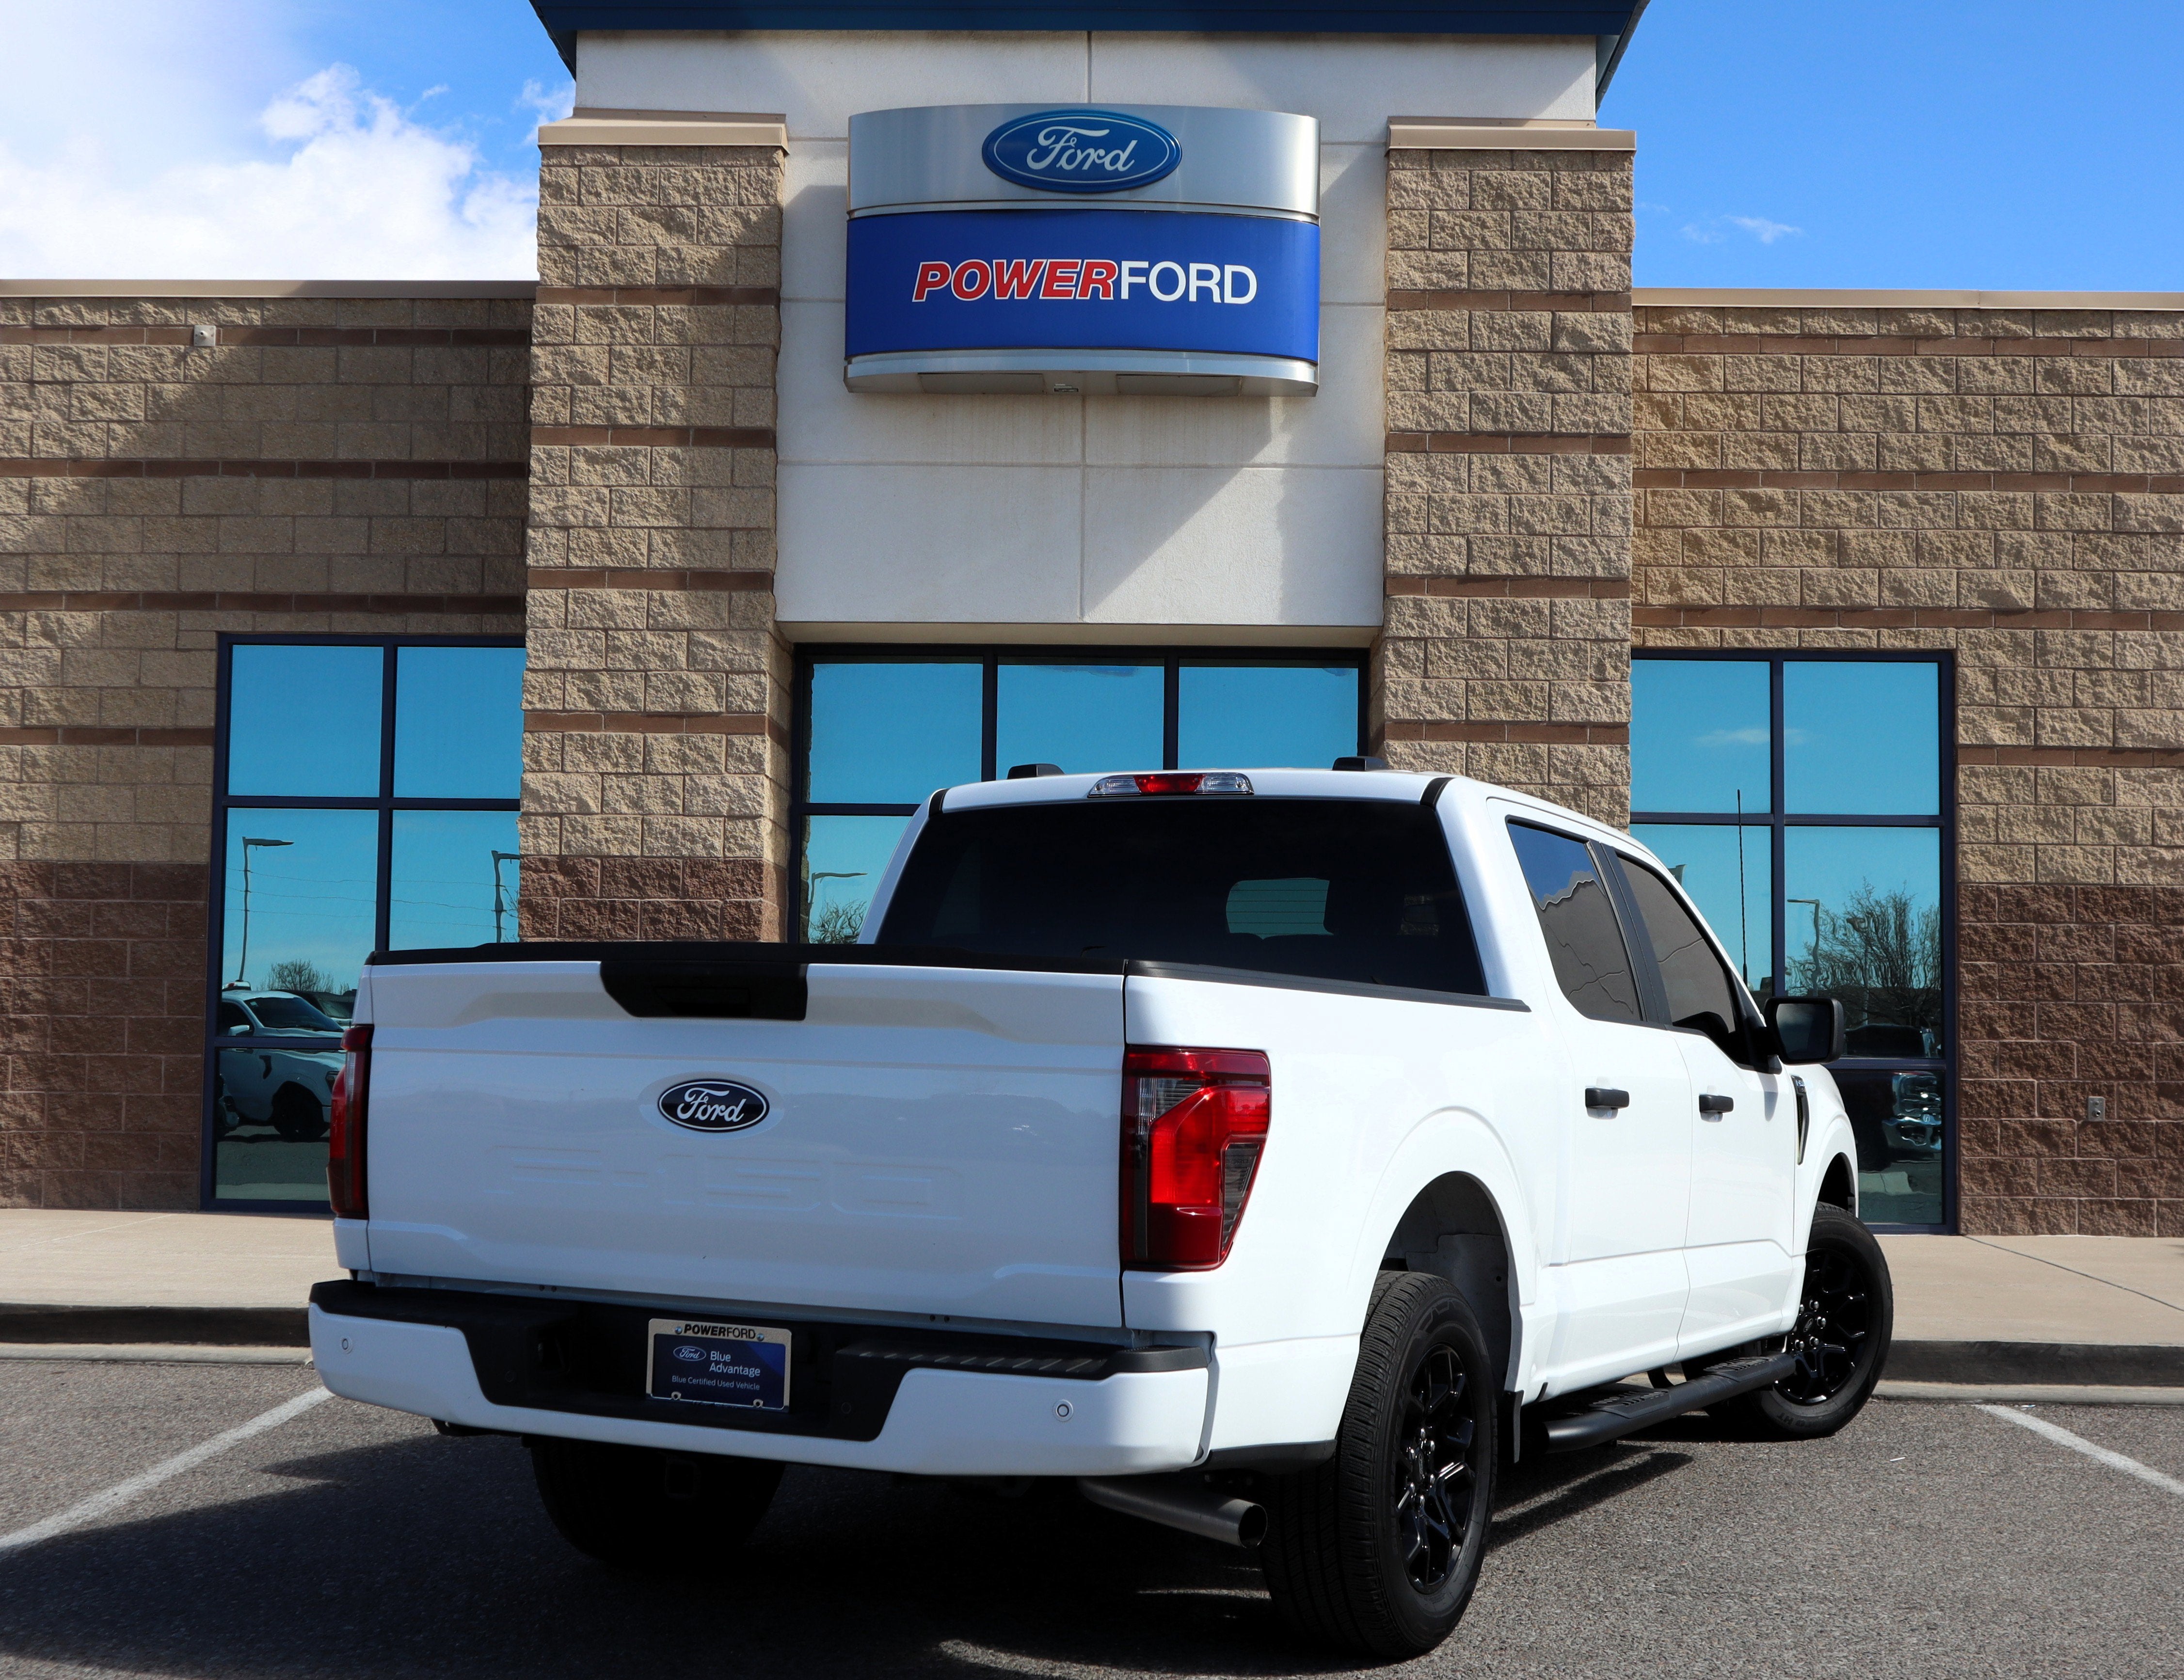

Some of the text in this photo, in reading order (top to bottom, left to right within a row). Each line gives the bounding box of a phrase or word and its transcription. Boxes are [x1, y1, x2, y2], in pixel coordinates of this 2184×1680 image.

[1025, 126, 1139, 173] Ford
[676, 1087, 747, 1122] Ford
[684, 1324, 756, 1339] POWERFORD
[679, 1347, 701, 1360] Ford
[710, 1351, 731, 1362] Blue
[709, 1363, 761, 1378] Advantage
[672, 1375, 761, 1391] Blue Certified Used Vehicle
